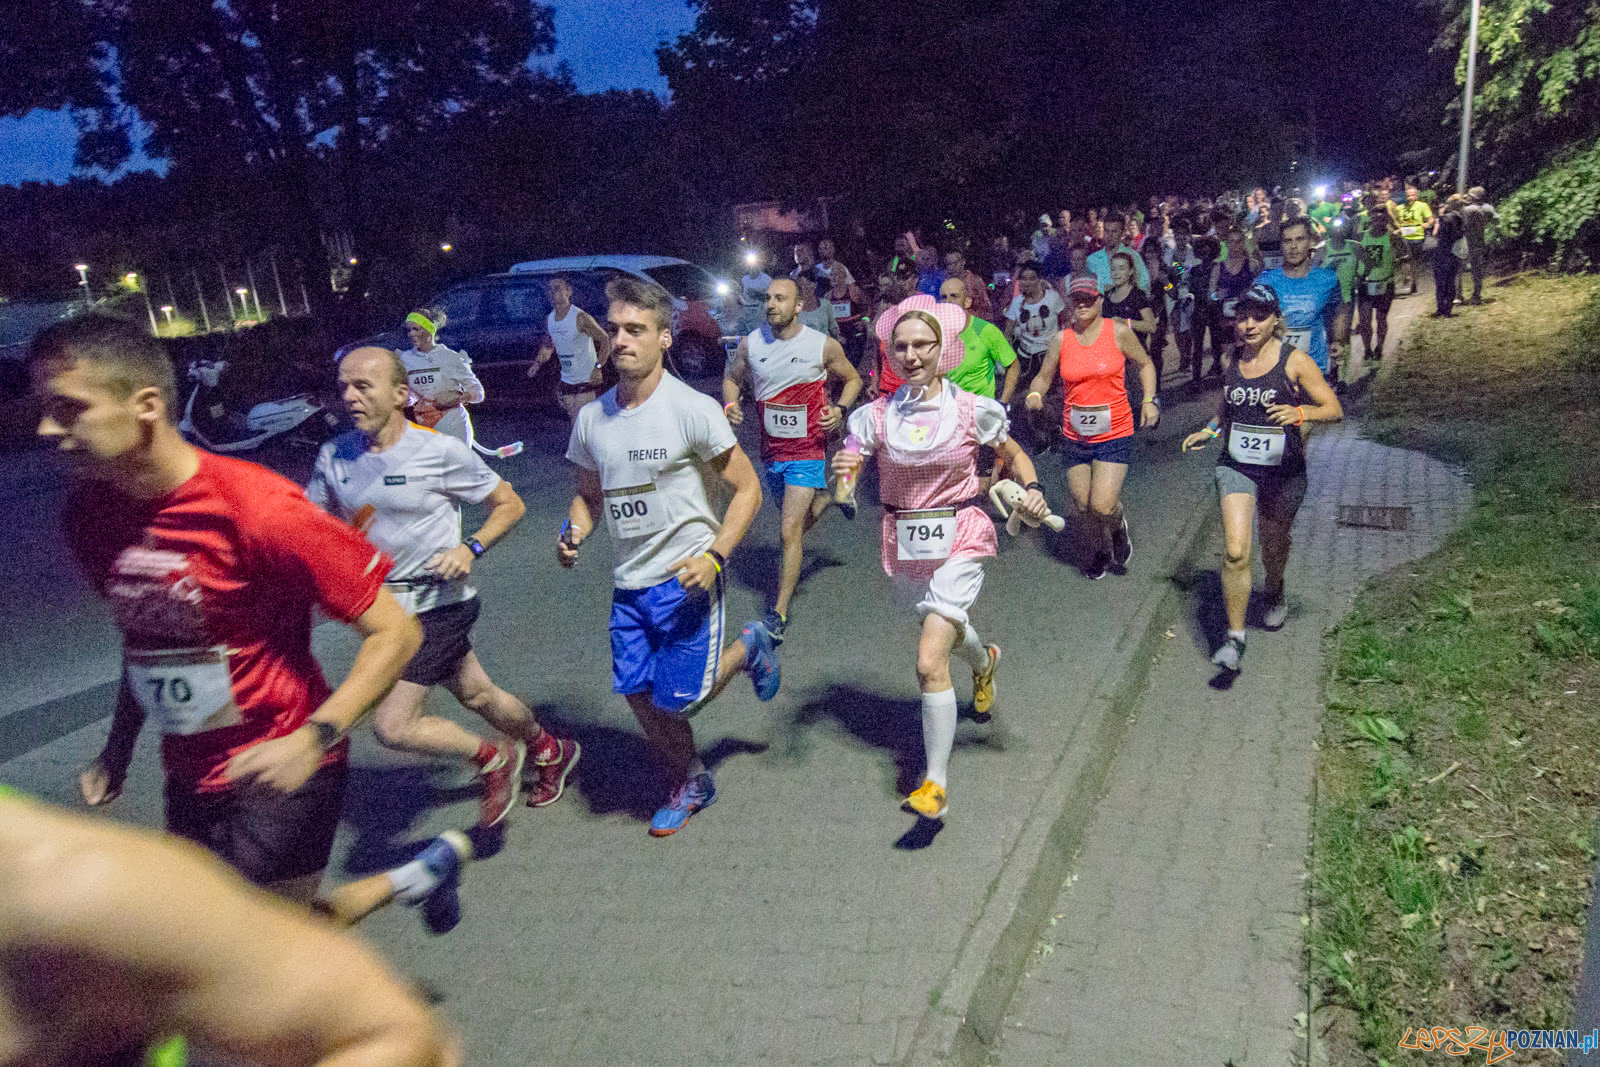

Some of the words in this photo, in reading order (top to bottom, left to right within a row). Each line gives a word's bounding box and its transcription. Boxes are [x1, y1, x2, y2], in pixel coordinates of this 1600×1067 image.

[414, 375, 434, 384] 405
[1223, 385, 1277, 408] LOVE
[772, 414, 798, 426] 163
[1080, 415, 1097, 425] 22
[1240, 436, 1271, 451] 321
[628, 448, 668, 461] TRENER
[610, 500, 648, 520] 600
[906, 524, 945, 541] 794
[147, 678, 192, 703] 70
